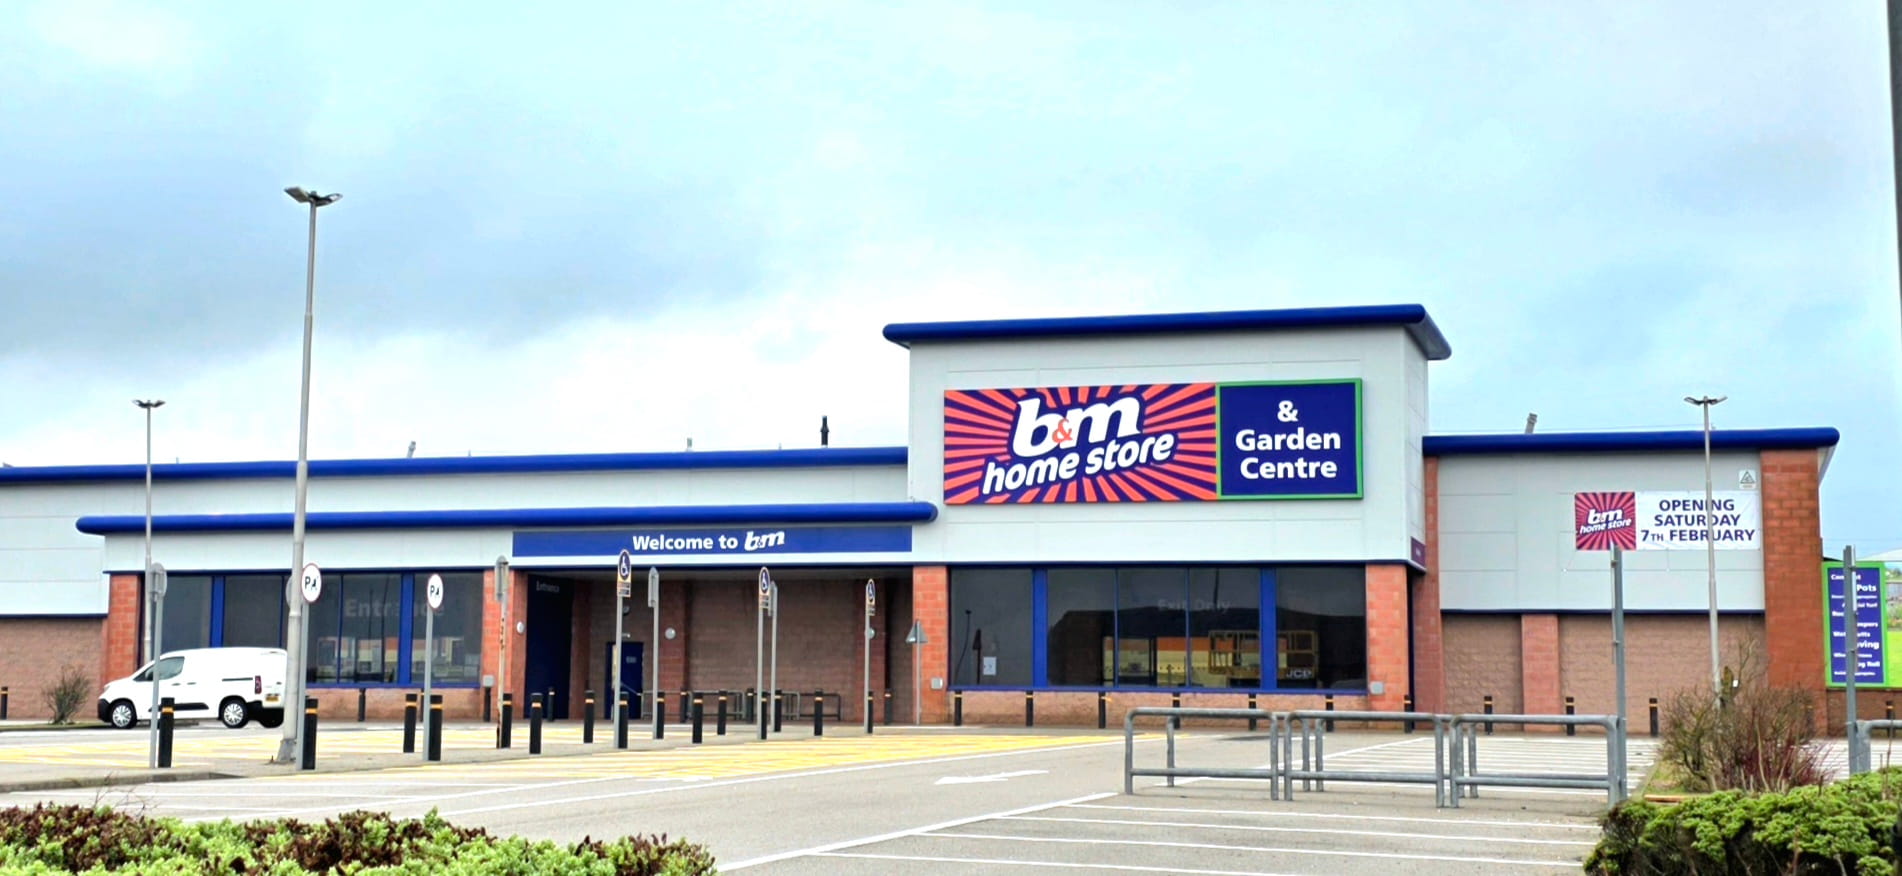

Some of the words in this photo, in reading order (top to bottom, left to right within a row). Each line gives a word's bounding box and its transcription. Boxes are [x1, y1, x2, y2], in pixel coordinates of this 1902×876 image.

[1277, 400, 1299, 422] &
[1012, 397, 1140, 457] b&m
[1235, 428, 1341, 452] Garden
[982, 454, 1079, 495] home
[1085, 432, 1175, 474] store
[1240, 457, 1338, 480] Centre
[1659, 499, 1735, 512] OPENING
[1580, 523, 1606, 535] home
[1607, 518, 1632, 529] store
[1654, 514, 1741, 527] SATURDAY
[632, 534, 713, 551] Welcome
[719, 536, 738, 550] to
[1641, 530, 1664, 542] 7TH
[1670, 529, 1755, 542] FEBRUARY
